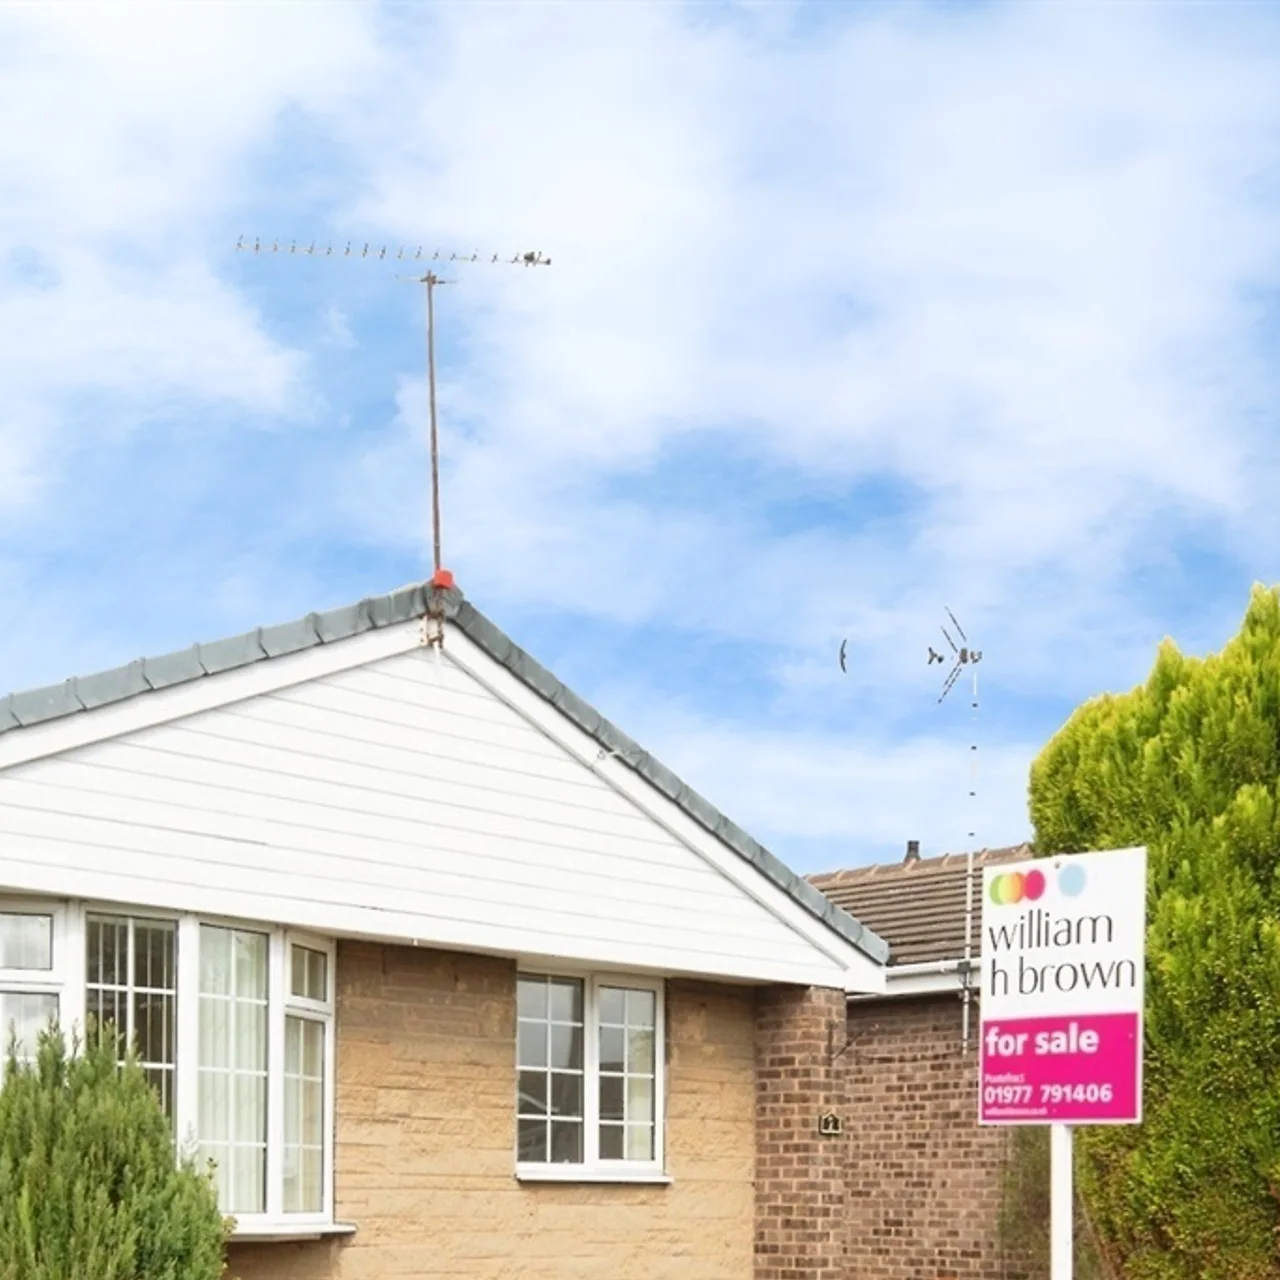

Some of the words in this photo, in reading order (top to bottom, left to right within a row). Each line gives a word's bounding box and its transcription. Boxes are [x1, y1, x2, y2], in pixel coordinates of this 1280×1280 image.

[989, 908, 1113, 951] william
[991, 958, 1008, 996] h
[1019, 956, 1135, 994] brown
[985, 1026, 1029, 1057] for
[1035, 1021, 1100, 1054] sale
[984, 1086, 1032, 1104] 01977
[1040, 1083, 1113, 1104] 791406
